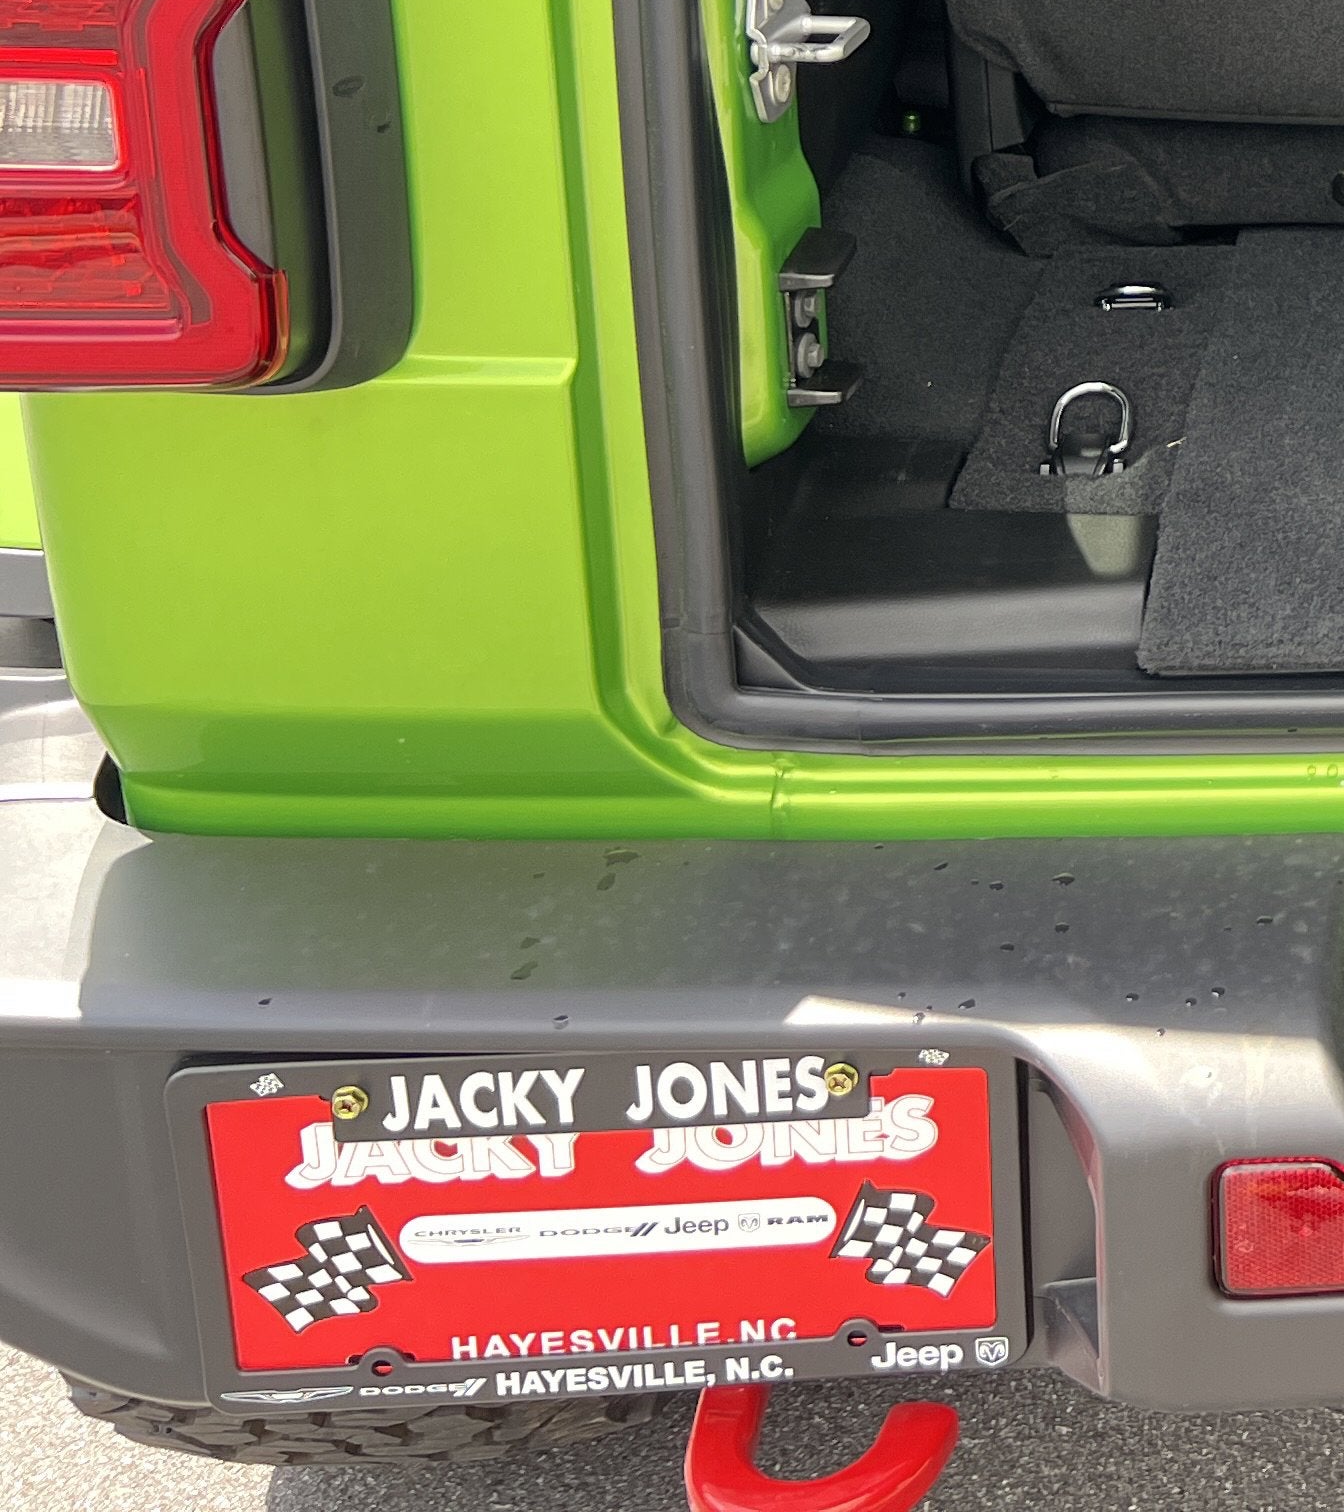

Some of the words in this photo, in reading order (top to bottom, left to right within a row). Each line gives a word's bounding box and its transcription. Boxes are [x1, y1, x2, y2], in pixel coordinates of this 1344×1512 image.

[383, 1067, 585, 1133] JACKY
[626, 1055, 830, 1125] JONES
[285, 1121, 582, 1188] JACKY
[636, 1094, 939, 1174] JONES
[664, 1214, 730, 1236] Jeep
[766, 1213, 829, 1226] RAM
[414, 1226, 522, 1239] CHRYSLER
[539, 1225, 635, 1238] DODGE
[871, 1341, 964, 1372] Jeep
[495, 1359, 716, 1397] HAYESVILLE,
[725, 1354, 795, 1382] N.C.
[359, 1382, 470, 1397] DODGE
